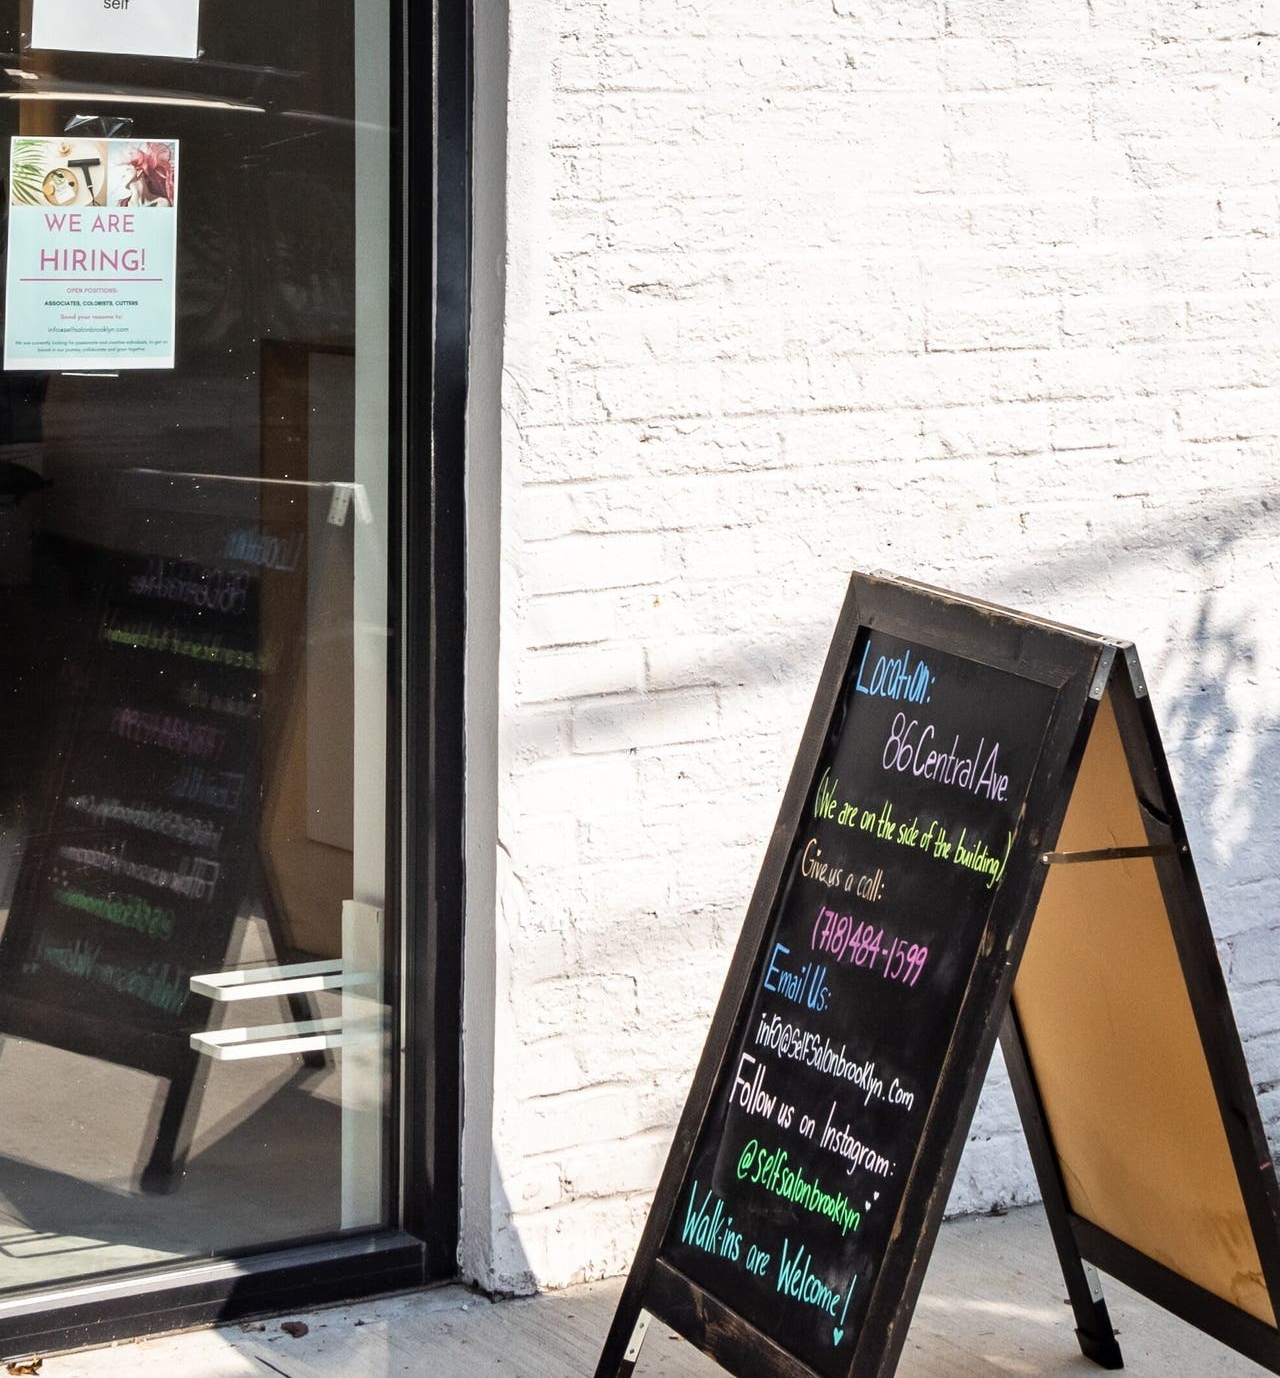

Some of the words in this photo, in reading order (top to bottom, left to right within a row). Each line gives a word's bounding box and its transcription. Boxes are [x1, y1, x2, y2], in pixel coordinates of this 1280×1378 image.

[40, 248, 146, 272] HIRING!
[45, 213, 82, 233] WE
[91, 214, 135, 233] ARE
[855, 640, 936, 704] Location:
[882, 712, 919, 772] 86
[912, 725, 985, 791] Central
[974, 742, 1009, 802] Ave.
[814, 766, 839, 819] (We
[838, 802, 859, 827] are
[860, 809, 876, 833] on
[876, 800, 897, 840] the
[896, 817, 920, 847] side
[919, 820, 938, 852] of
[933, 827, 952, 859] the
[953, 828, 1012, 890] building)
[801, 838, 828, 883] Give
[827, 867, 843, 887] us
[844, 873, 854, 892] a
[856, 868, 885, 902] call:
[763, 943, 813, 1004] Email
[807, 965, 833, 1011] Us:
[811, 905, 929, 988] (718)484-1599
[728, 1052, 777, 1120] Follow
[777, 1102, 796, 1129] us
[798, 1114, 817, 1140] on
[819, 1101, 897, 1178] Instagram:
[681, 1180, 743, 1262] Walk-ins
[746, 1243, 771, 1277] are
[776, 1238, 858, 1326] Welcome!
